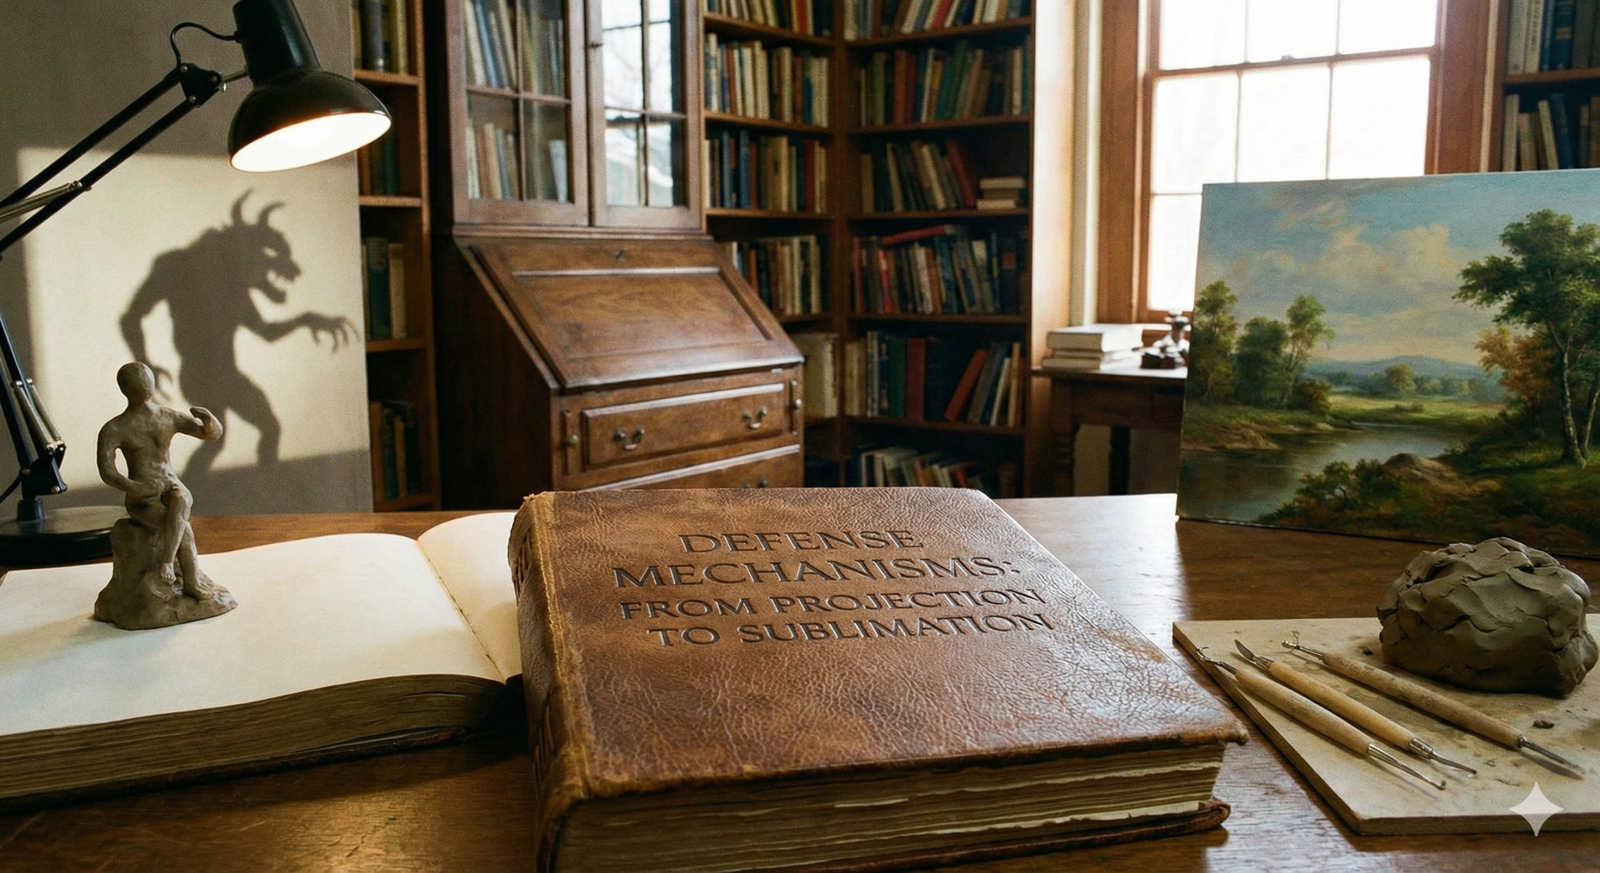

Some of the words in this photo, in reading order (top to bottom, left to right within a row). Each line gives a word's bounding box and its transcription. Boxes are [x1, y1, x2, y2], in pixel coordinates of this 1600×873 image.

[678, 530, 924, 553] DEFENSE
[612, 556, 1021, 588] MECHANISMS:
[620, 597, 755, 620] FROM
[768, 588, 1047, 614] PROJECTION
[647, 627, 719, 647] TO
[737, 613, 1056, 643] SUBLIMATION
